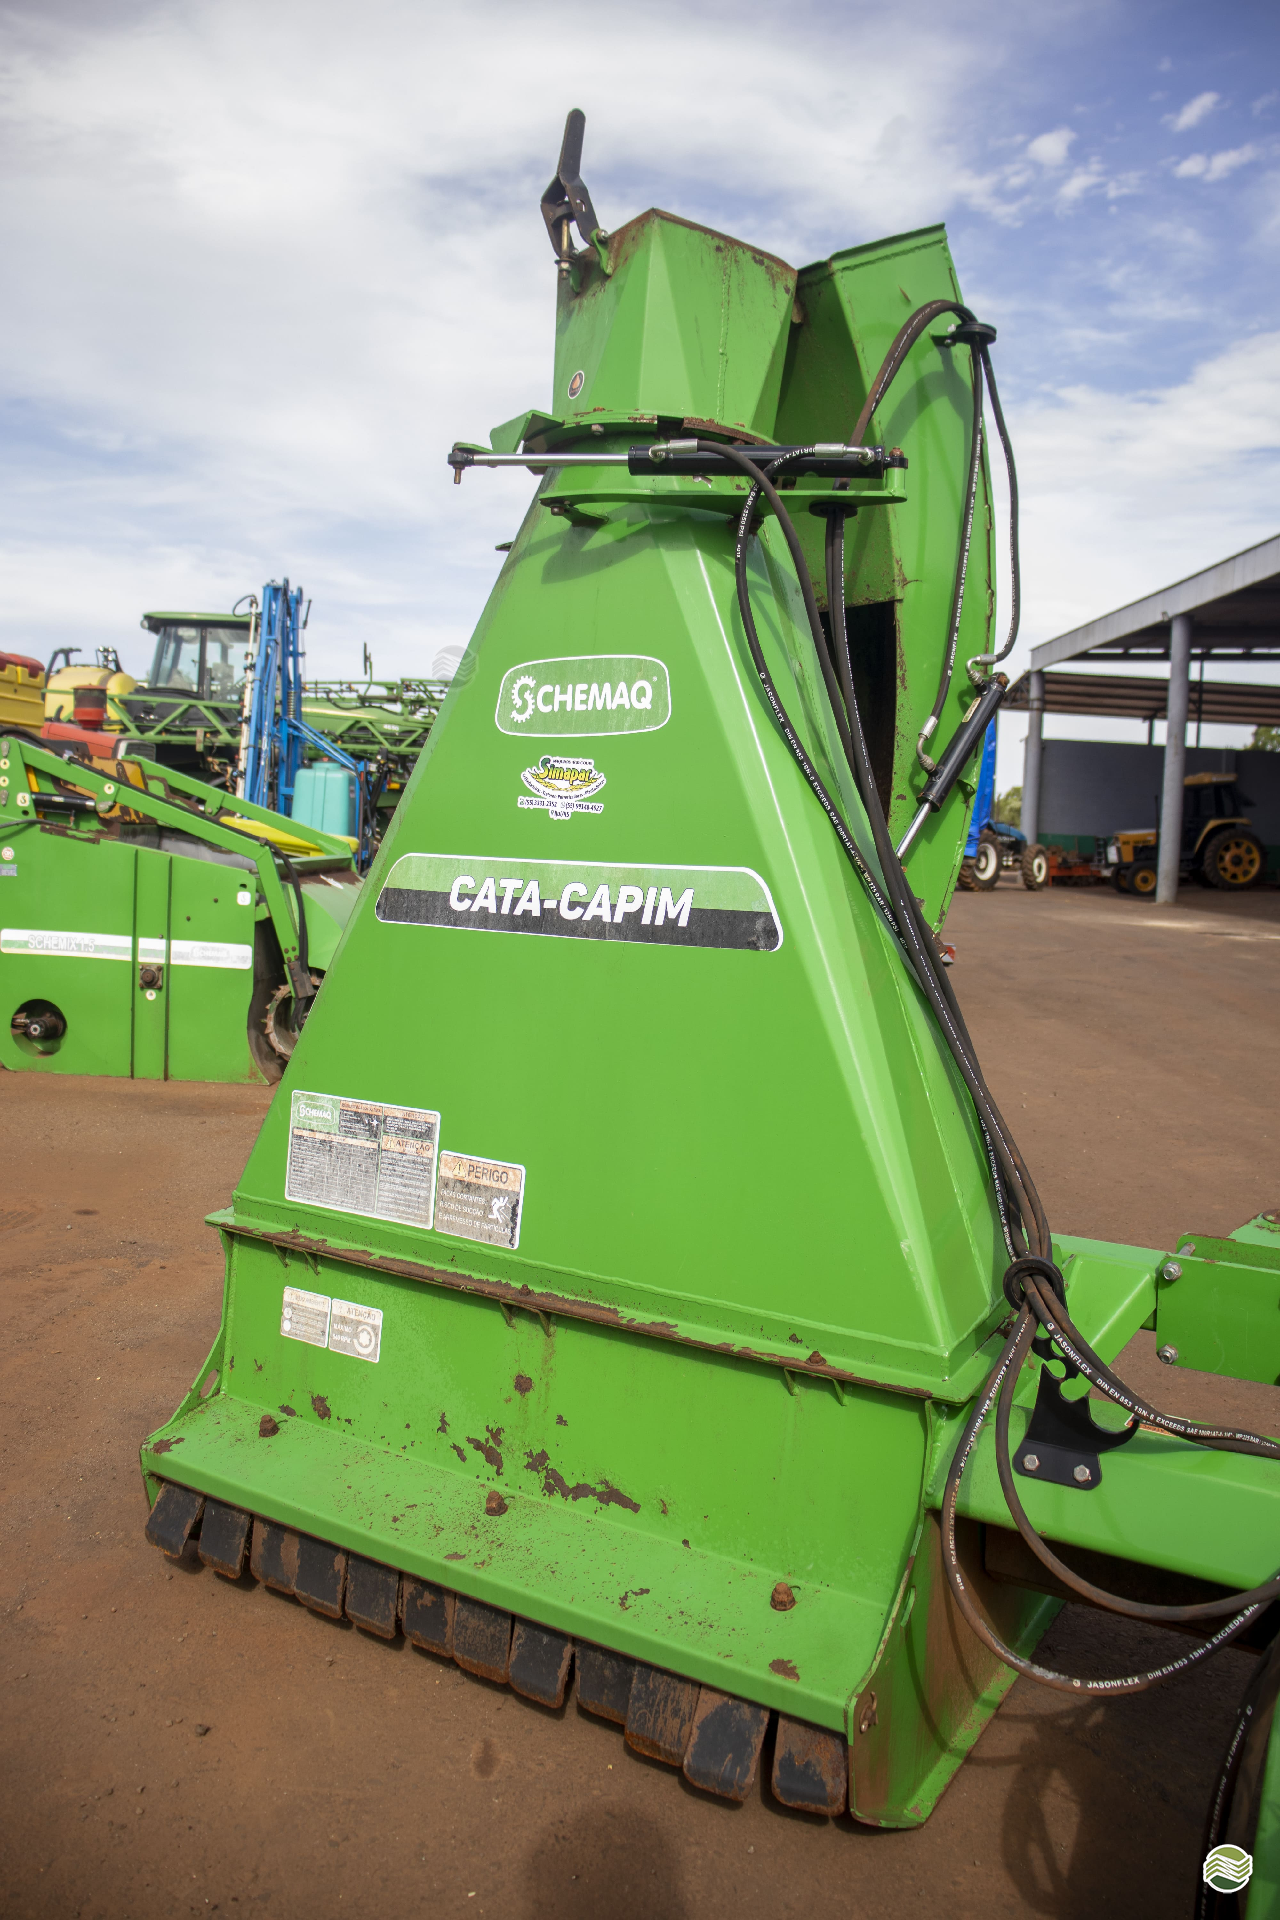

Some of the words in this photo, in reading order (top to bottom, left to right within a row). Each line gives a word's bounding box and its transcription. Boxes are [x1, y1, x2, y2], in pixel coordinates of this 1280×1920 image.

[511, 675, 653, 724] SCHEMAQ
[541, 757, 592, 786] Simapar
[449, 875, 695, 928] CATA-CAPIM
[28, 934, 77, 951] SCHEMIX
[79, 938, 95, 952] 1.5
[299, 1104, 332, 1119] SCHEMAQ
[396, 1139, 431, 1153] ATENÇÃO
[468, 1164, 508, 1184] PERIGO
[989, 1365, 1007, 1398] EXCEEDS
[1054, 1333, 1092, 1375] JASONFLEX
[1096, 1378, 1110, 1391] DIN
[1109, 1388, 1120, 1399] EN
[1119, 1396, 1133, 1408] 853
[1156, 1417, 1185, 1432] EXCEEDS
[1186, 1427, 1197, 1435] SAE
[981, 1399, 991, 1415] SAE
[1087, 1676, 1140, 1689] JASONFLEX
[1147, 1670, 1163, 1680] DIN
[1162, 1665, 1174, 1675] EN
[1174, 1657, 1188, 1669] 853
[1212, 1615, 1245, 1645] EXCEEDS
